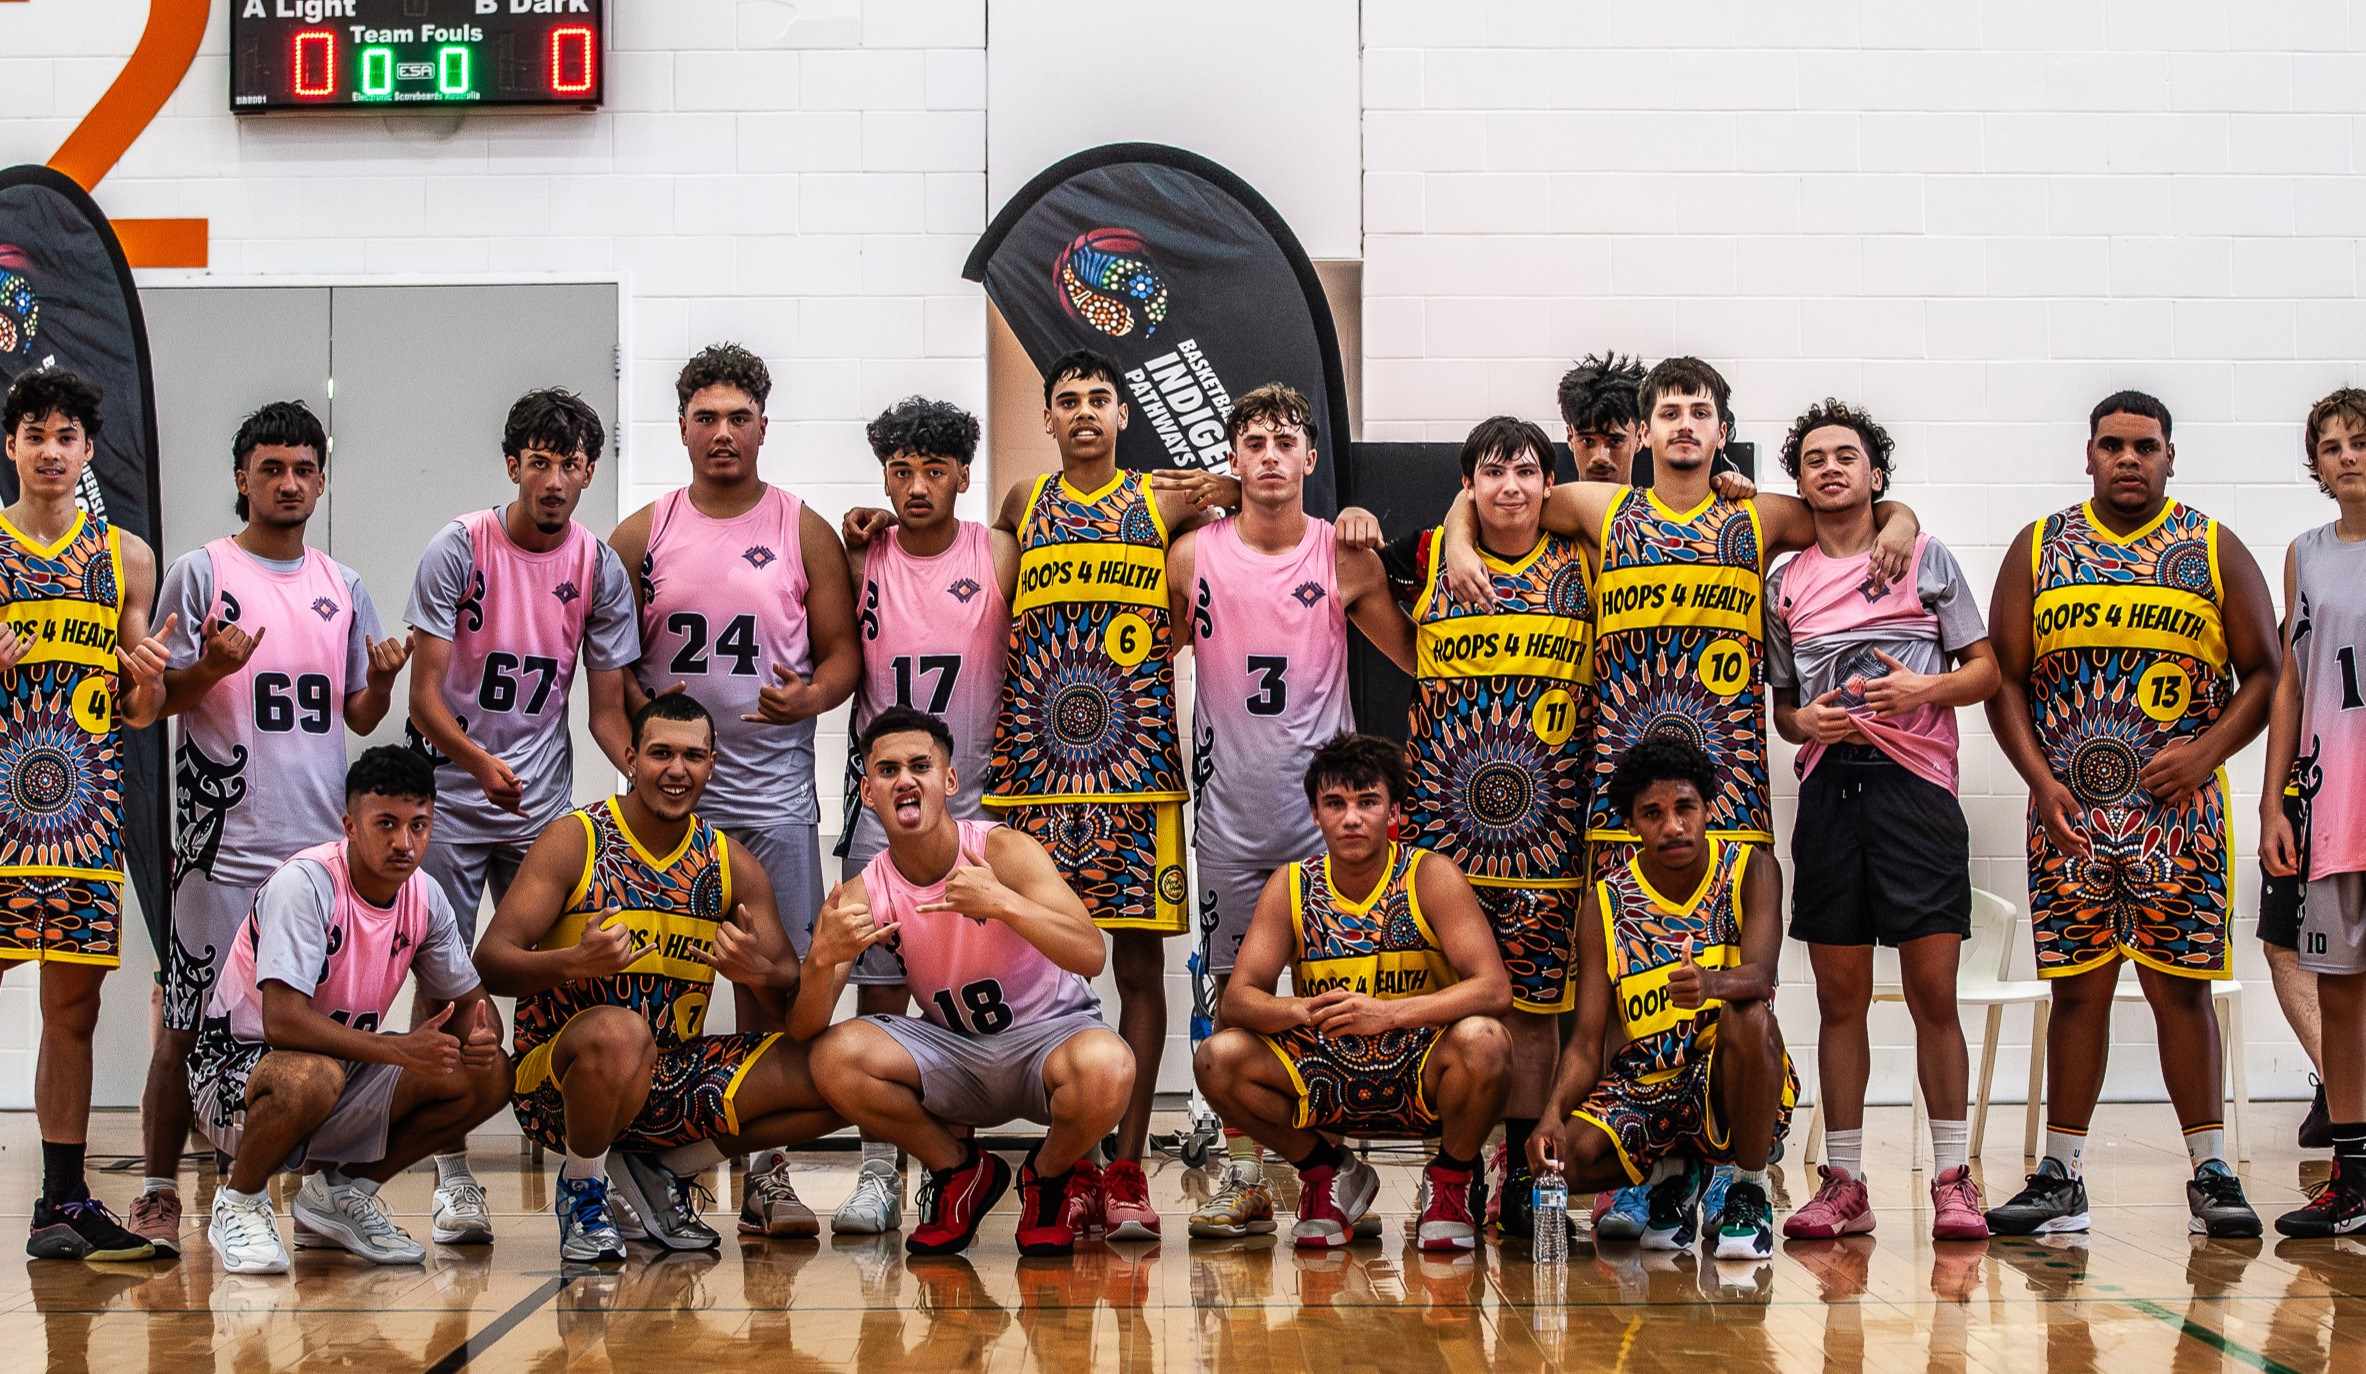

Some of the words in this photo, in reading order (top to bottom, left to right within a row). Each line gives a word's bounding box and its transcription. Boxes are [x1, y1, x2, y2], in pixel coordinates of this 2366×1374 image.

[242, 0, 267, 19] A
[275, 0, 356, 24] Light
[474, 0, 498, 14] B
[509, 0, 590, 14] Dark
[349, 25, 417, 43] Team
[420, 24, 483, 43] Fouls
[294, 31, 335, 95] 0
[362, 48, 392, 95] 0
[438, 47, 469, 94] 0
[552, 28, 592, 92] 0
[1176, 338, 1237, 425] BASKETBA
[1124, 368, 1197, 468] PATHWAYS
[1021, 560, 1073, 597] HOOPS
[1077, 561, 1093, 584] 4
[1096, 560, 1162, 591] HEALTH
[1603, 583, 1667, 618] HOOPS
[1671, 583, 1688, 608] 4
[1690, 584, 1757, 616] HEALTH
[42, 618, 57, 643] 4
[1119, 624, 1137, 654] 6
[2035, 602, 2101, 640] HOOPS
[2105, 603, 2122, 628] 4
[2127, 603, 2207, 641] HEALTH
[666, 611, 761, 677] 24
[1433, 633, 1500, 664] HOOPS
[1504, 633, 1520, 658] 4
[477, 650, 560, 717] 67
[889, 654, 963, 716] 17
[1245, 653, 1290, 718] 3
[1710, 652, 1742, 683] 10
[87, 690, 106, 720] 4
[252, 671, 332, 735] 69
[2149, 675, 2182, 708] 13
[1544, 702, 1569, 732] 11
[2306, 931, 2328, 955] 10
[932, 977, 1015, 1035] 18
[1624, 985, 1671, 1024] OOP
